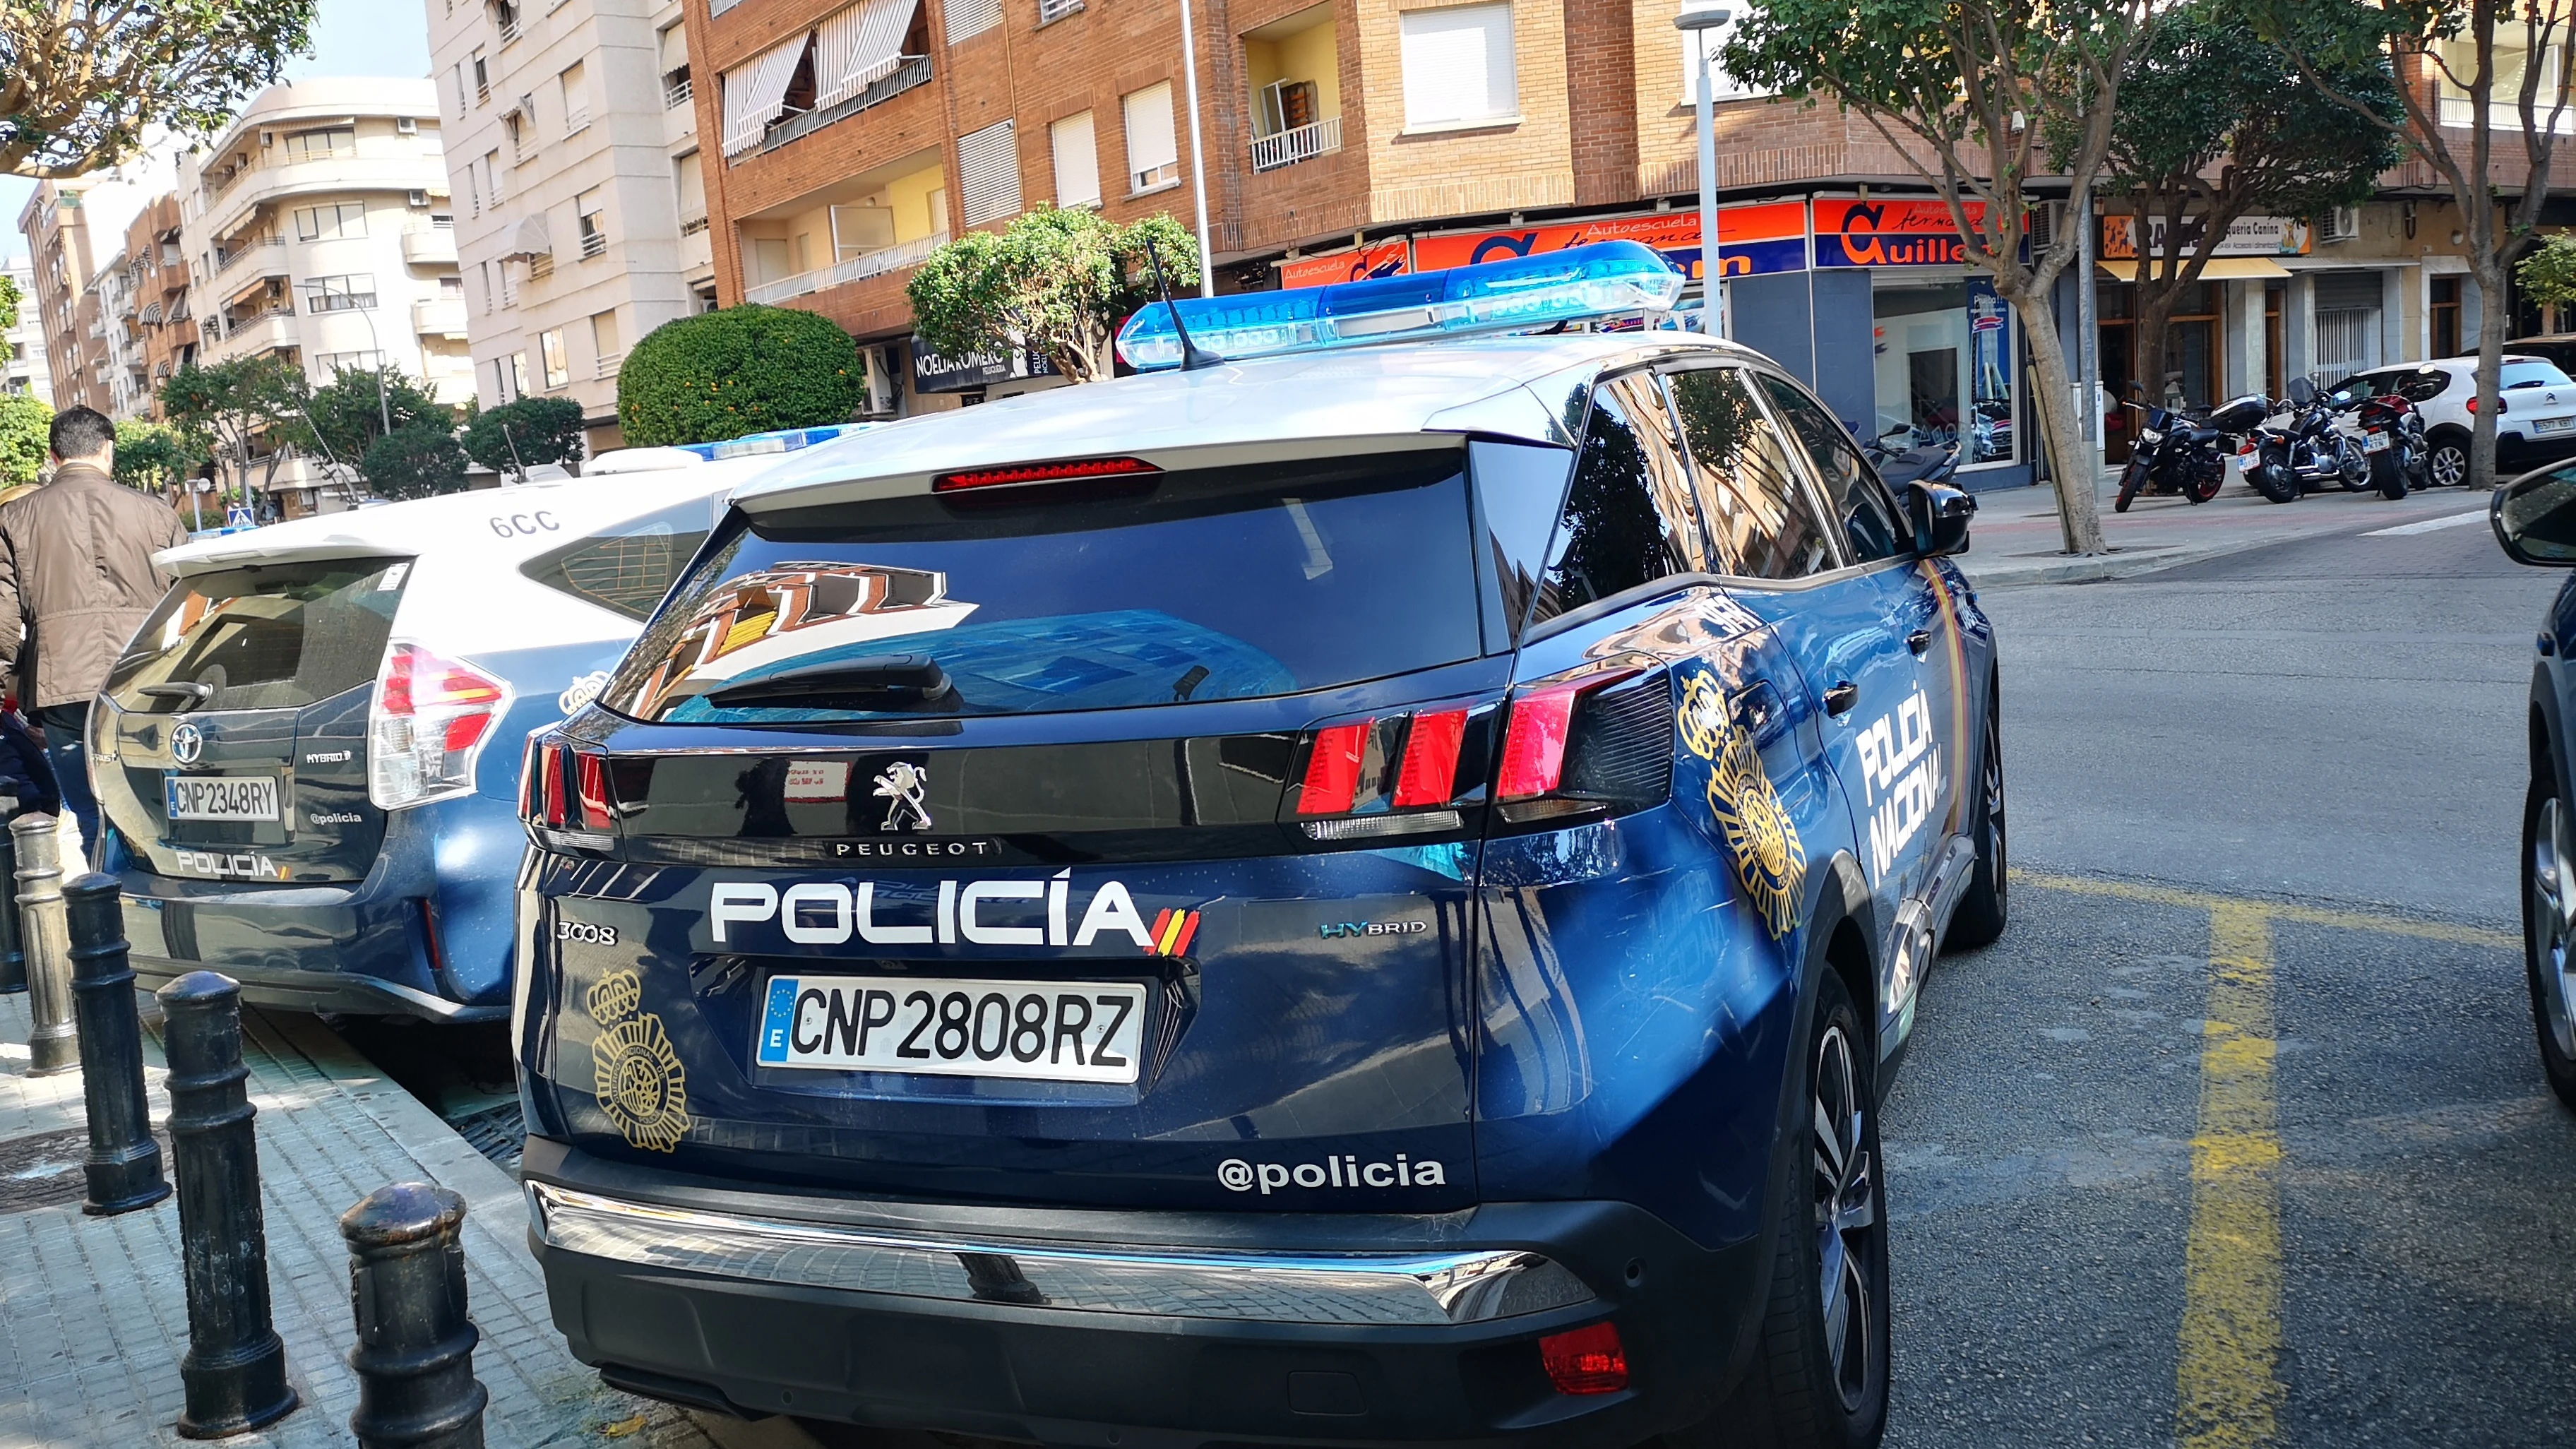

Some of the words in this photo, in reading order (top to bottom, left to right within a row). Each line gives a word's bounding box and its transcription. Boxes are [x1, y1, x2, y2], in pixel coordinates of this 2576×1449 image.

[1586, 215, 1697, 237] Autoescuela
[2226, 222, 2251, 237] queria
[2253, 222, 2279, 234] Canina
[1284, 258, 1345, 280] Autoescuela
[915, 353, 955, 378] NOELIA
[489, 511, 560, 538] 6CC
[176, 782, 273, 815] CNP2348RY
[310, 812, 363, 825] @policia
[1870, 743, 1948, 890] NACIONAL
[836, 842, 988, 857] PEUGEOT
[176, 850, 278, 877] POLICÍA
[710, 867, 1155, 947] POLICÍA
[556, 921, 619, 947] 3008
[1320, 921, 1428, 940] HYBRID
[770, 1029, 782, 1047] E
[790, 989, 1134, 1067] CNP2808RZ
[621, 1046, 655, 1063] NACIONAL
[655, 1064, 667, 1080] DE
[1217, 1153, 1446, 1195] @policia
